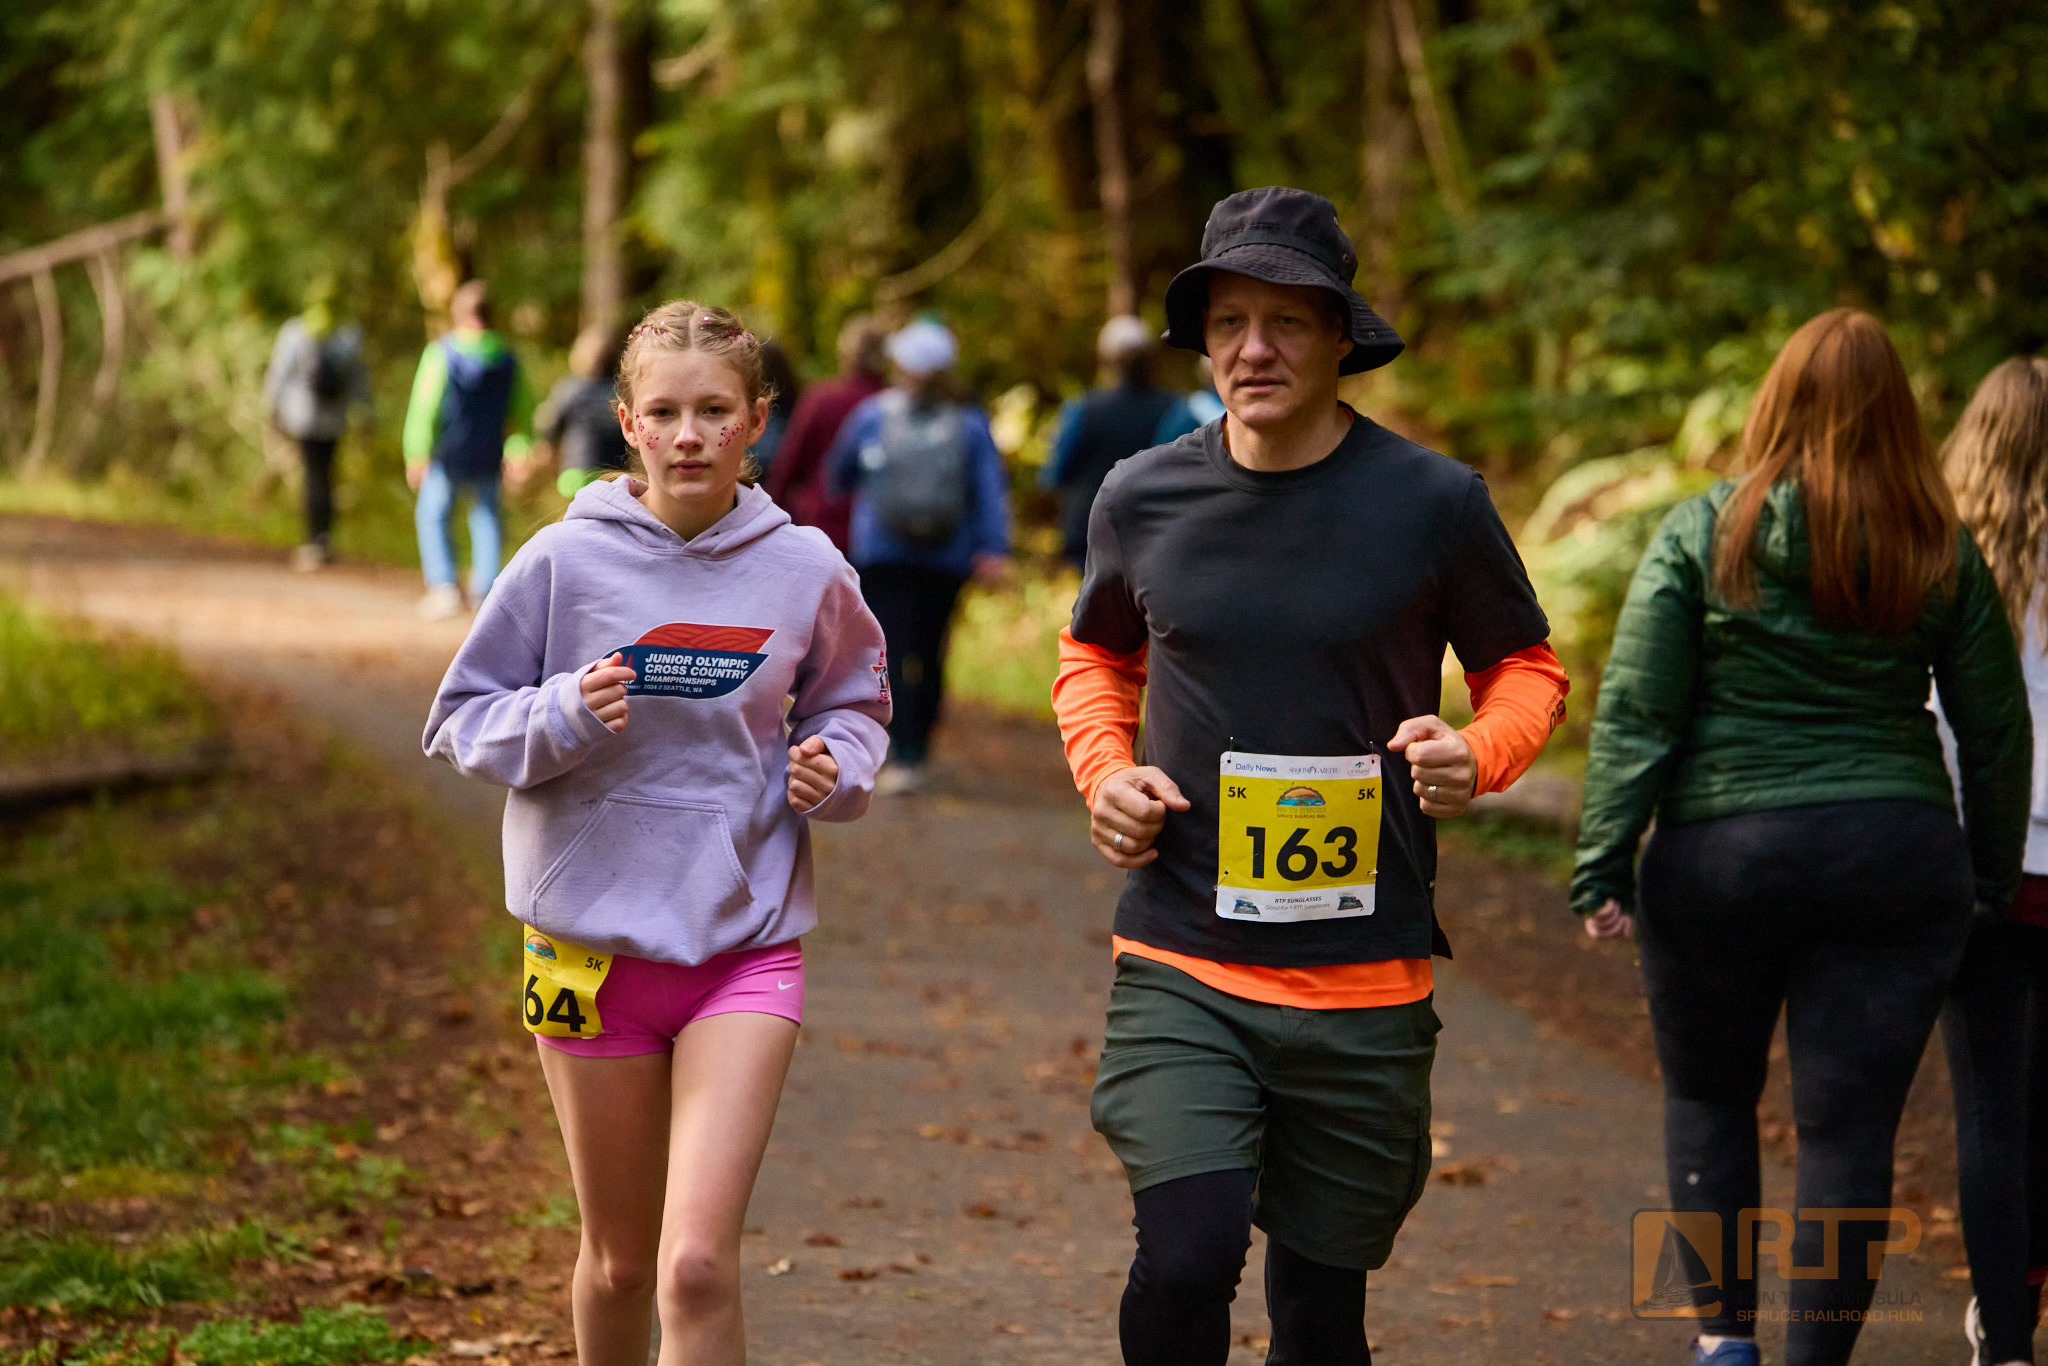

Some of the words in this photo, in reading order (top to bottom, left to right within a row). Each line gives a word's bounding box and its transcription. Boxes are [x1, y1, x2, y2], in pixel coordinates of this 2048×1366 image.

[645, 653, 692, 666] JUNIOR
[696, 656, 749, 669] OLYMPIC
[645, 664, 687, 675] CROSS
[690, 667, 748, 680] COUNTRY
[644, 675, 717, 686] CHAMPIONSHIPS
[663, 685, 692, 693] SEATTLE,
[1235, 763, 1253, 773] Daily
[1256, 764, 1277, 773] News
[1228, 786, 1247, 799] 5K
[1357, 788, 1375, 800] 5K
[1246, 826, 1358, 881] 163
[585, 957, 604, 972] 5K
